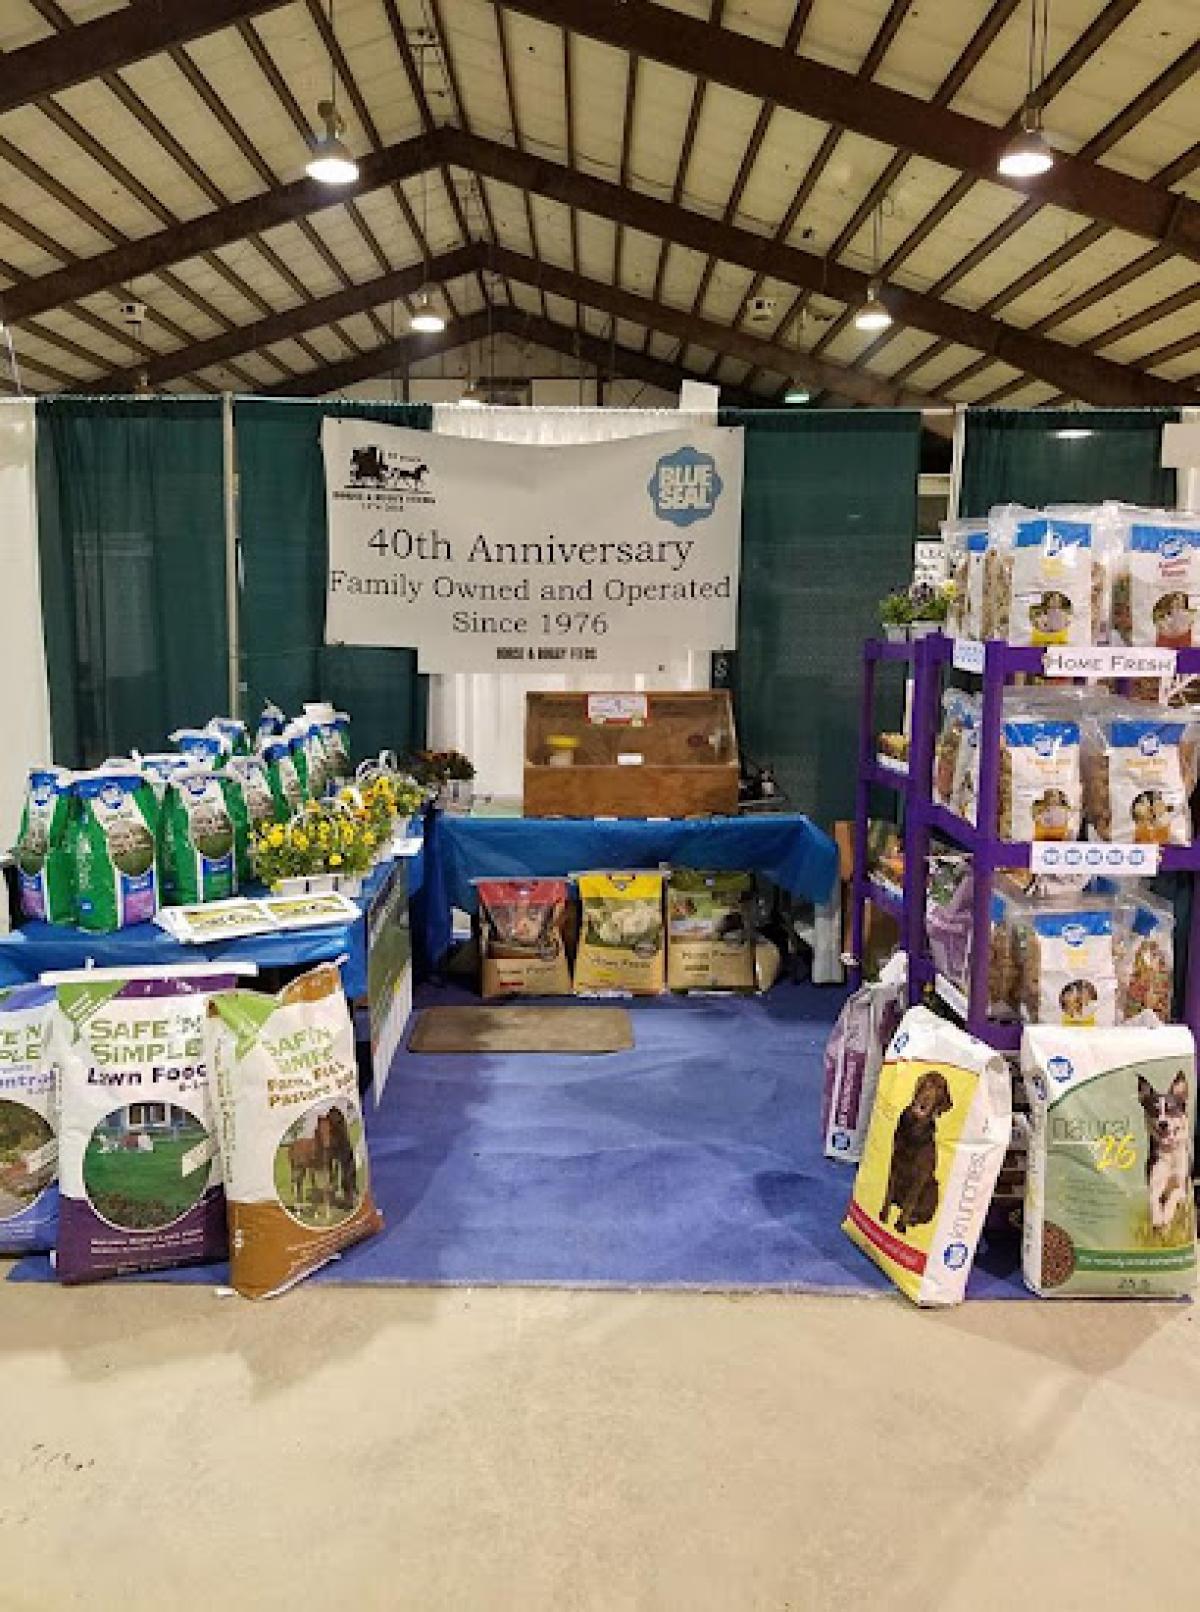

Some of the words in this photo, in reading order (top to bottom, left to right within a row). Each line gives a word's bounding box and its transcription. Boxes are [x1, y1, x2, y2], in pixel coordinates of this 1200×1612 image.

[367, 528, 454, 562] 40th
[467, 534, 695, 572] Anniversary
[329, 570, 424, 603] Family
[432, 575, 530, 602] Owned
[540, 578, 593, 602] and
[604, 575, 731, 606] Operated
[452, 610, 529, 635] Since
[541, 611, 609, 636] 1976
[1045, 652, 1103, 671] HOME
[1110, 654, 1172, 671] FRESH
[90, 1018, 169, 1040] SAFE
[90, 1037, 204, 1066] SIMPLE
[87, 1067, 143, 1086] Lawn
[1095, 1132, 1138, 1173] 26
